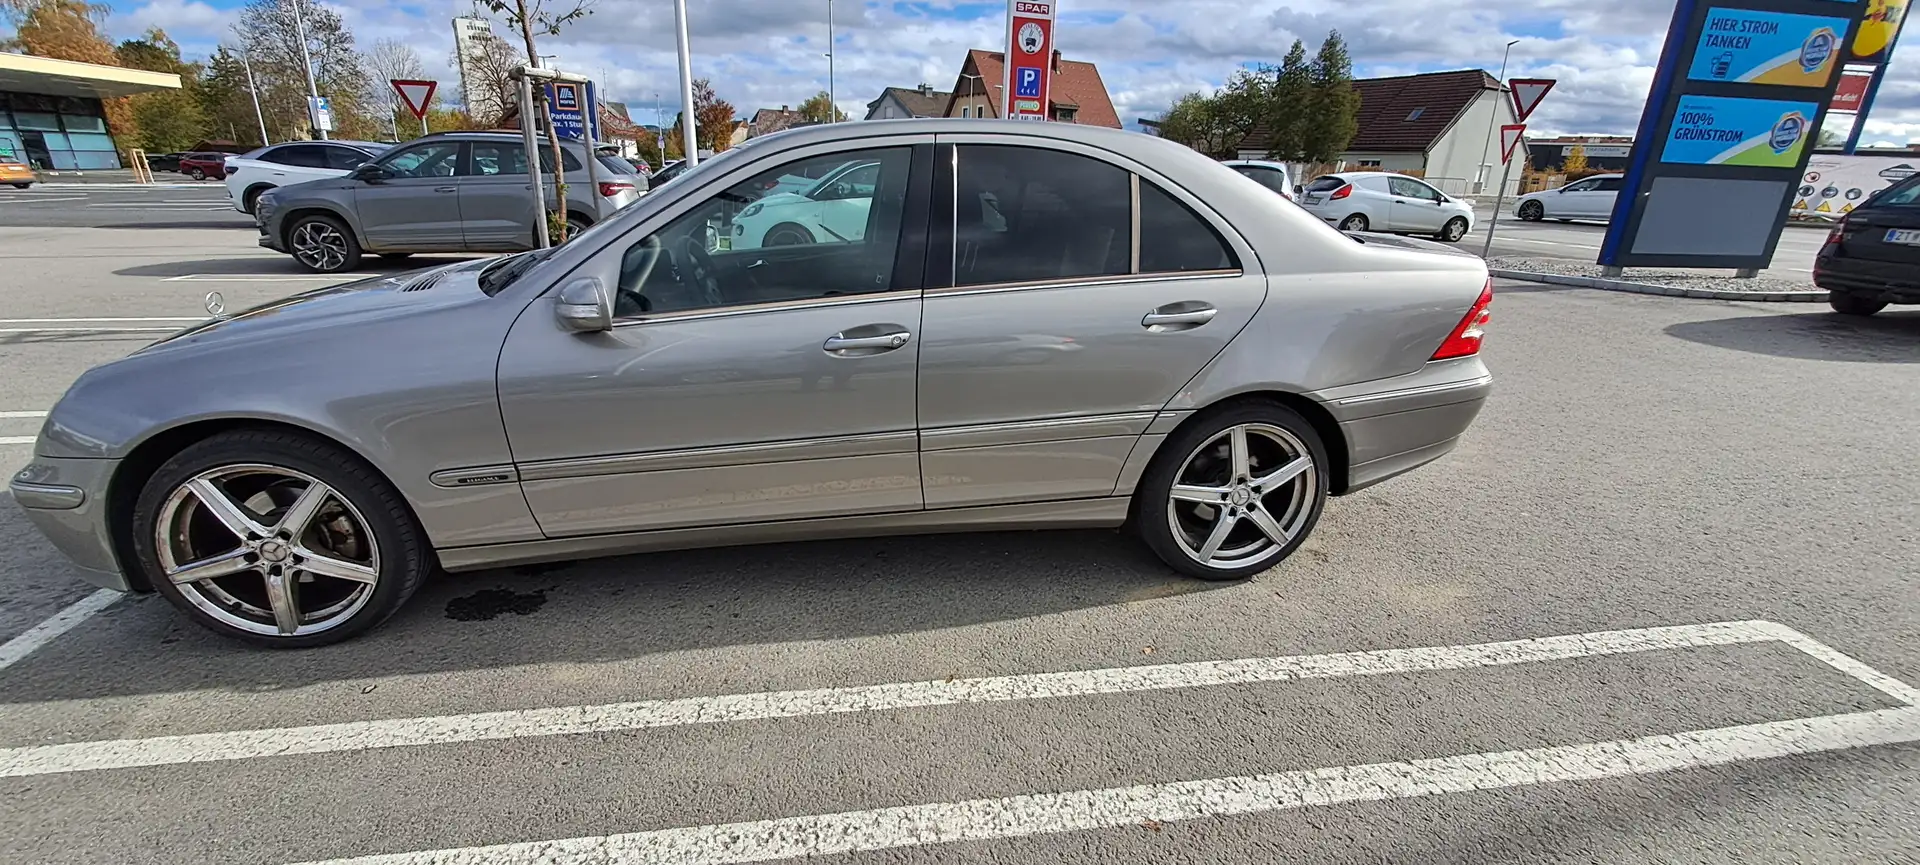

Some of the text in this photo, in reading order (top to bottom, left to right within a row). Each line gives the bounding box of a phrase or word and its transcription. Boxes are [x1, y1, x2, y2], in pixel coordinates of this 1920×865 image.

[1017, 3, 1049, 14] SPAR
[1710, 17, 1779, 35] HIER STROM
[1706, 34, 1752, 49] TANKEN
[1024, 70, 1035, 86] P
[1680, 112, 1714, 126] 100%
[1674, 125, 1743, 142] GRÜNSTROM
